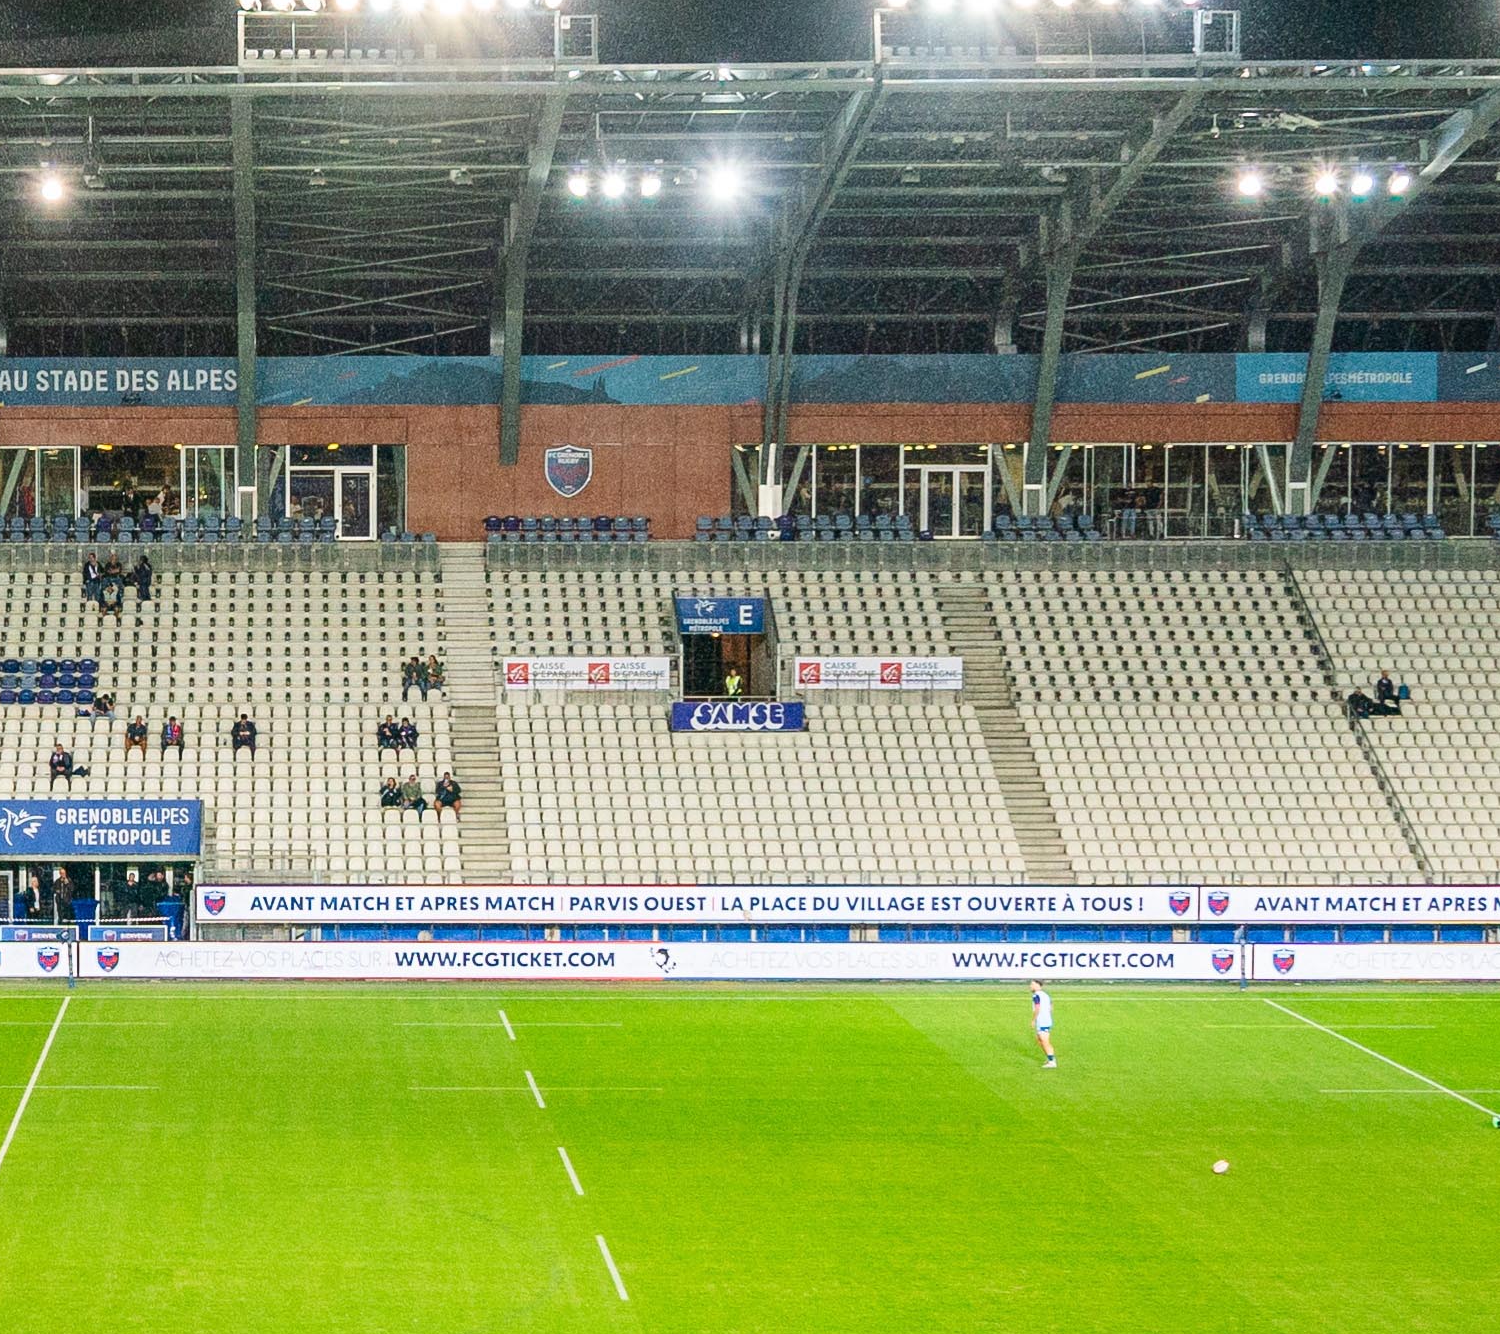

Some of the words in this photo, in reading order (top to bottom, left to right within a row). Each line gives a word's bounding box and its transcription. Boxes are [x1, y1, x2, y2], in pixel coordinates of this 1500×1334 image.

[0, 370, 27, 392] AU
[37, 370, 108, 392] STADE
[117, 370, 158, 392] DES
[168, 370, 237, 392] ALPES
[1259, 370, 1413, 384] GRENOBLPESMÉTROPOLE
[739, 604, 753, 625] E
[690, 703, 784, 731] SAMSE
[55, 807, 190, 825] GRENOBLEALPES
[74, 826, 171, 845] MÉTROPOLE
[250, 896, 315, 911] AVANT
[320, 896, 390, 911] MATCH
[395, 896, 415, 911] ET
[420, 896, 479, 911] APRES
[485, 896, 555, 911] MATCH
[569, 896, 639, 911] PARVIS
[644, 896, 707, 911] OUEST
[721, 896, 744, 911] LA
[750, 896, 807, 911] PLACE
[813, 896, 840, 911] DU
[845, 896, 925, 911] VILLAGE
[931, 896, 962, 911] EST
[967, 896, 1057, 912] OUVERTE
[1062, 893, 1075, 912] À
[1080, 897, 1133, 912] TOUS
[1254, 897, 1320, 912] AVANT
[1325, 896, 1396, 912] MATCH
[1402, 897, 1422, 912] ET
[1427, 897, 1487, 912] APRES
[394, 952, 615, 967] WWW.FCGTICKET.COM
[952, 952, 1174, 968] WWW.FCGTICKET.COM
